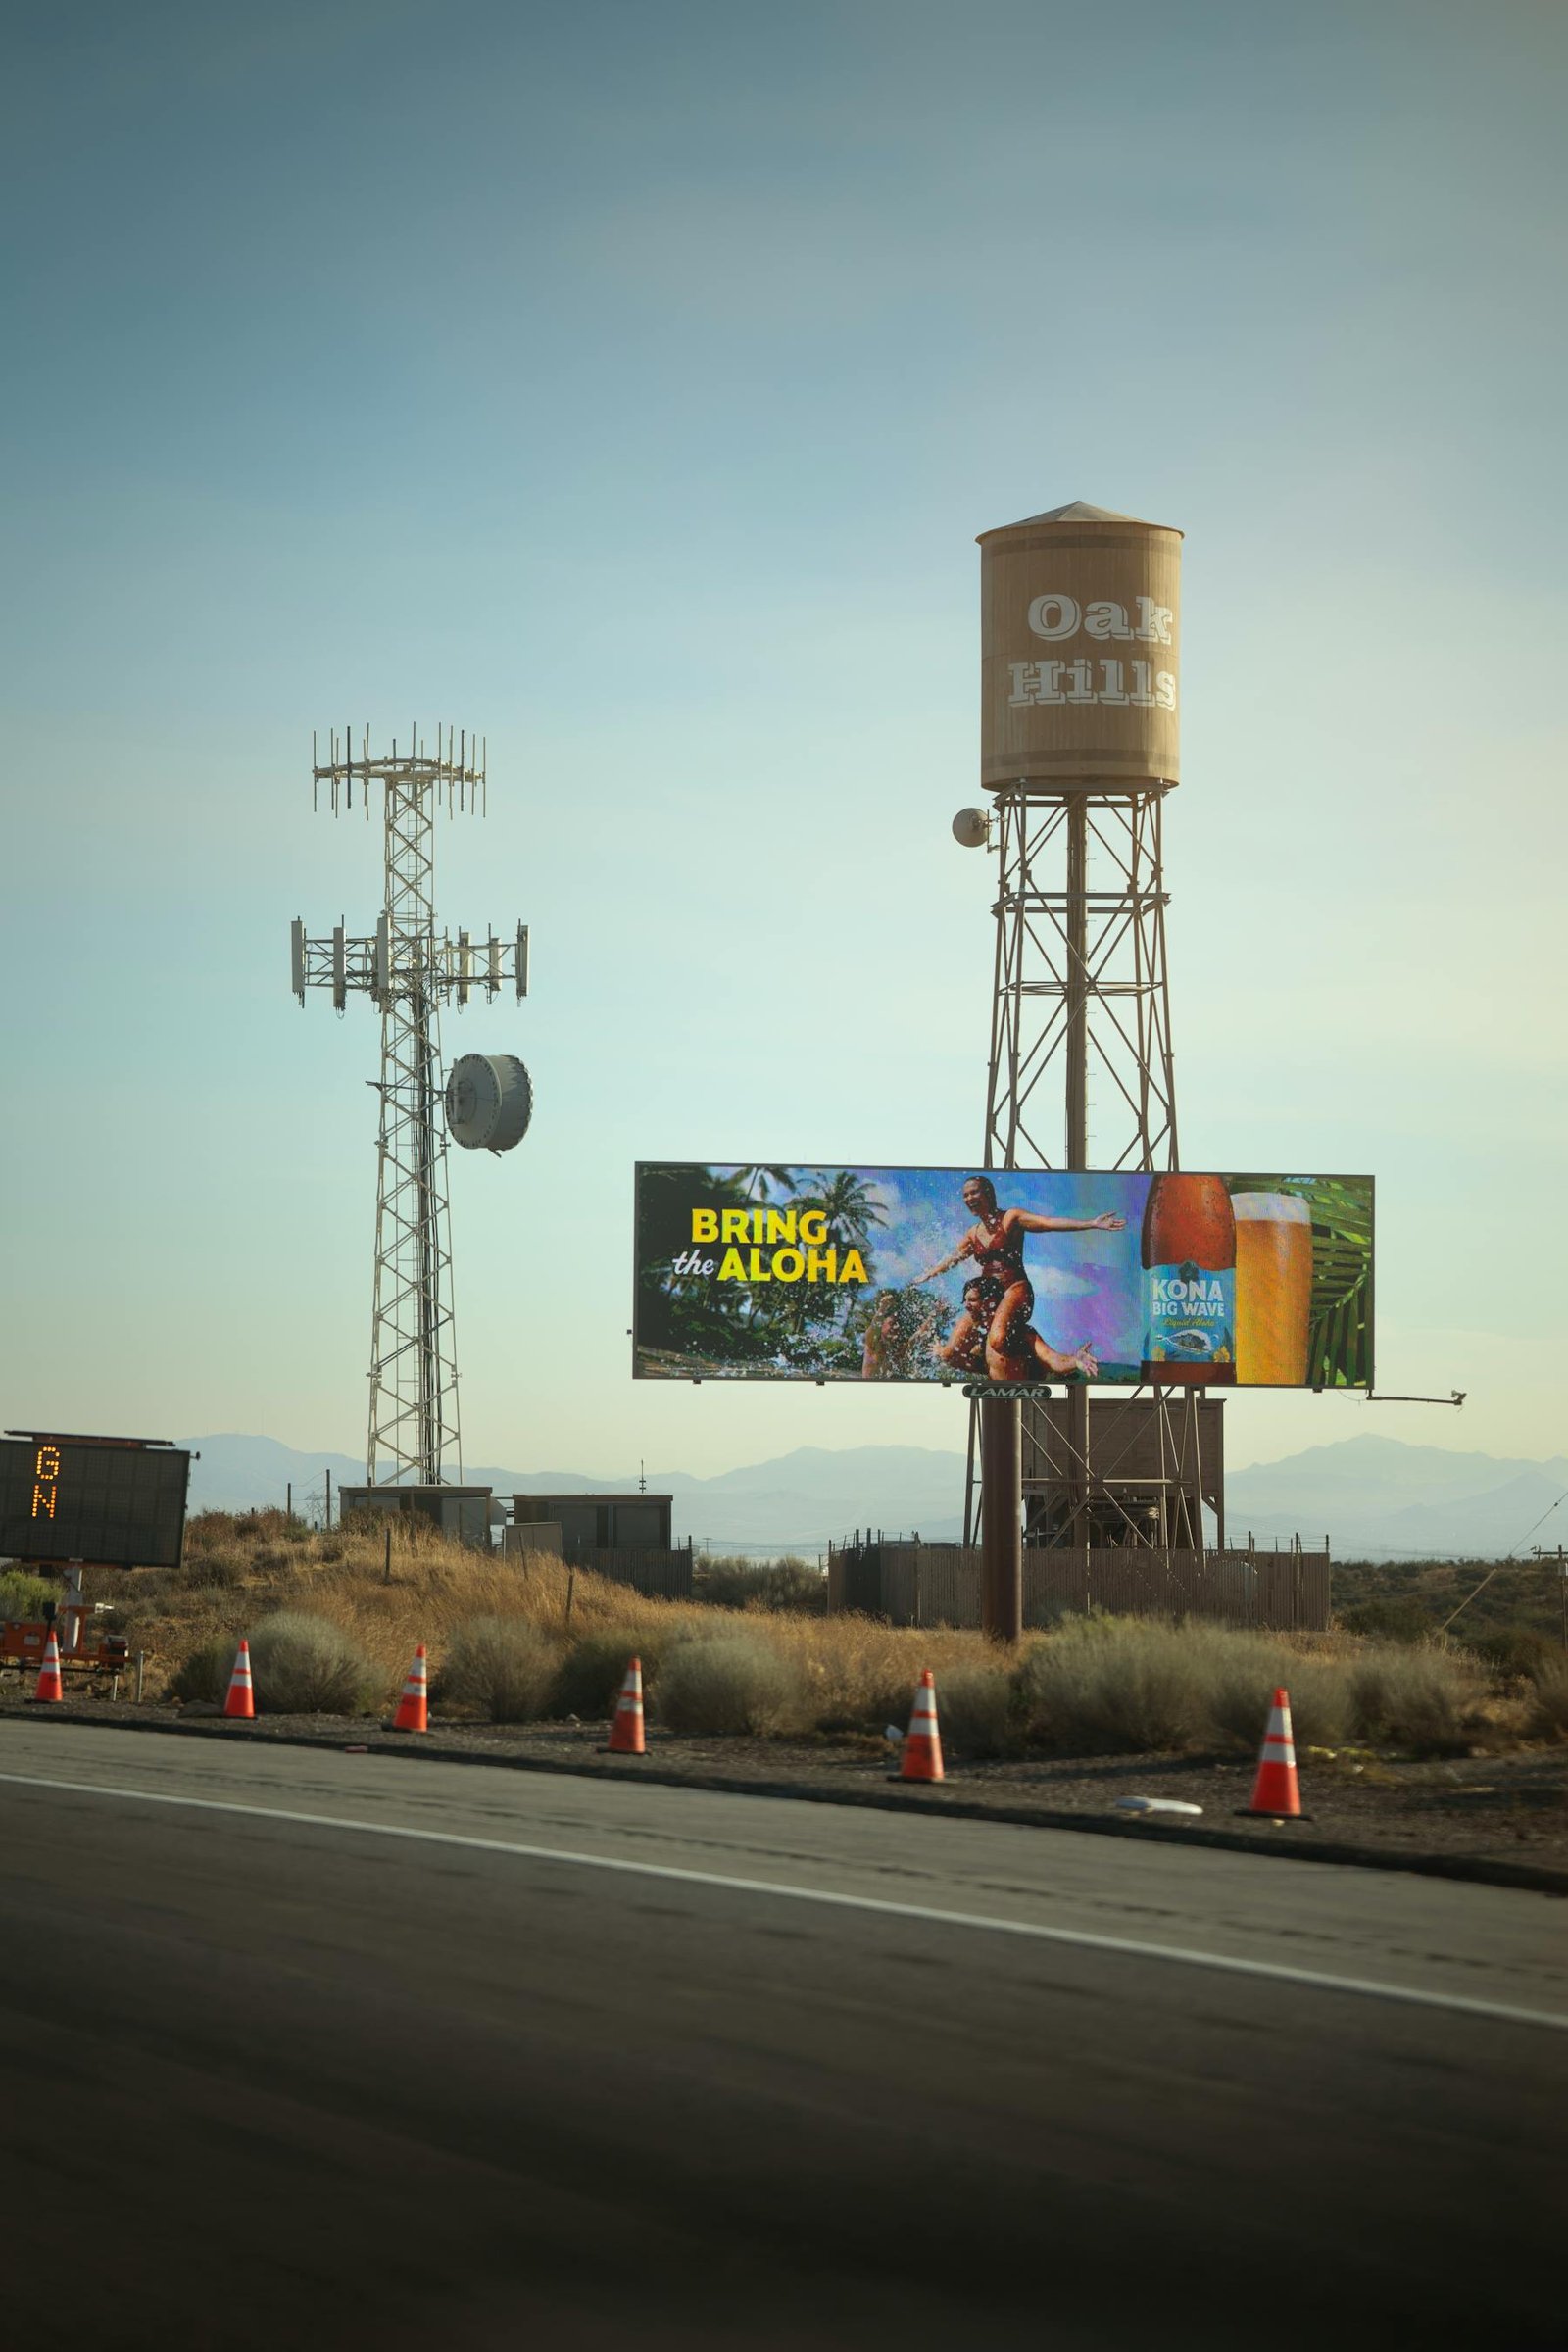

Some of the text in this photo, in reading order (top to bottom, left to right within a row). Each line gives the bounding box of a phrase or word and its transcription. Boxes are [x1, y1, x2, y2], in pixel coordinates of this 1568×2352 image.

[1028, 594, 1174, 645] Oak
[1007, 658, 1176, 711] Hills
[691, 1208, 828, 1246] BRING
[672, 1247, 870, 1284] the ALOHA
[1152, 1278, 1224, 1302] KONA
[1152, 1302, 1225, 1317] BIG WAVE
[970, 1387, 1045, 1397] LAMAR
[36, 1446, 61, 1481] G
[31, 1484, 58, 1519] N
